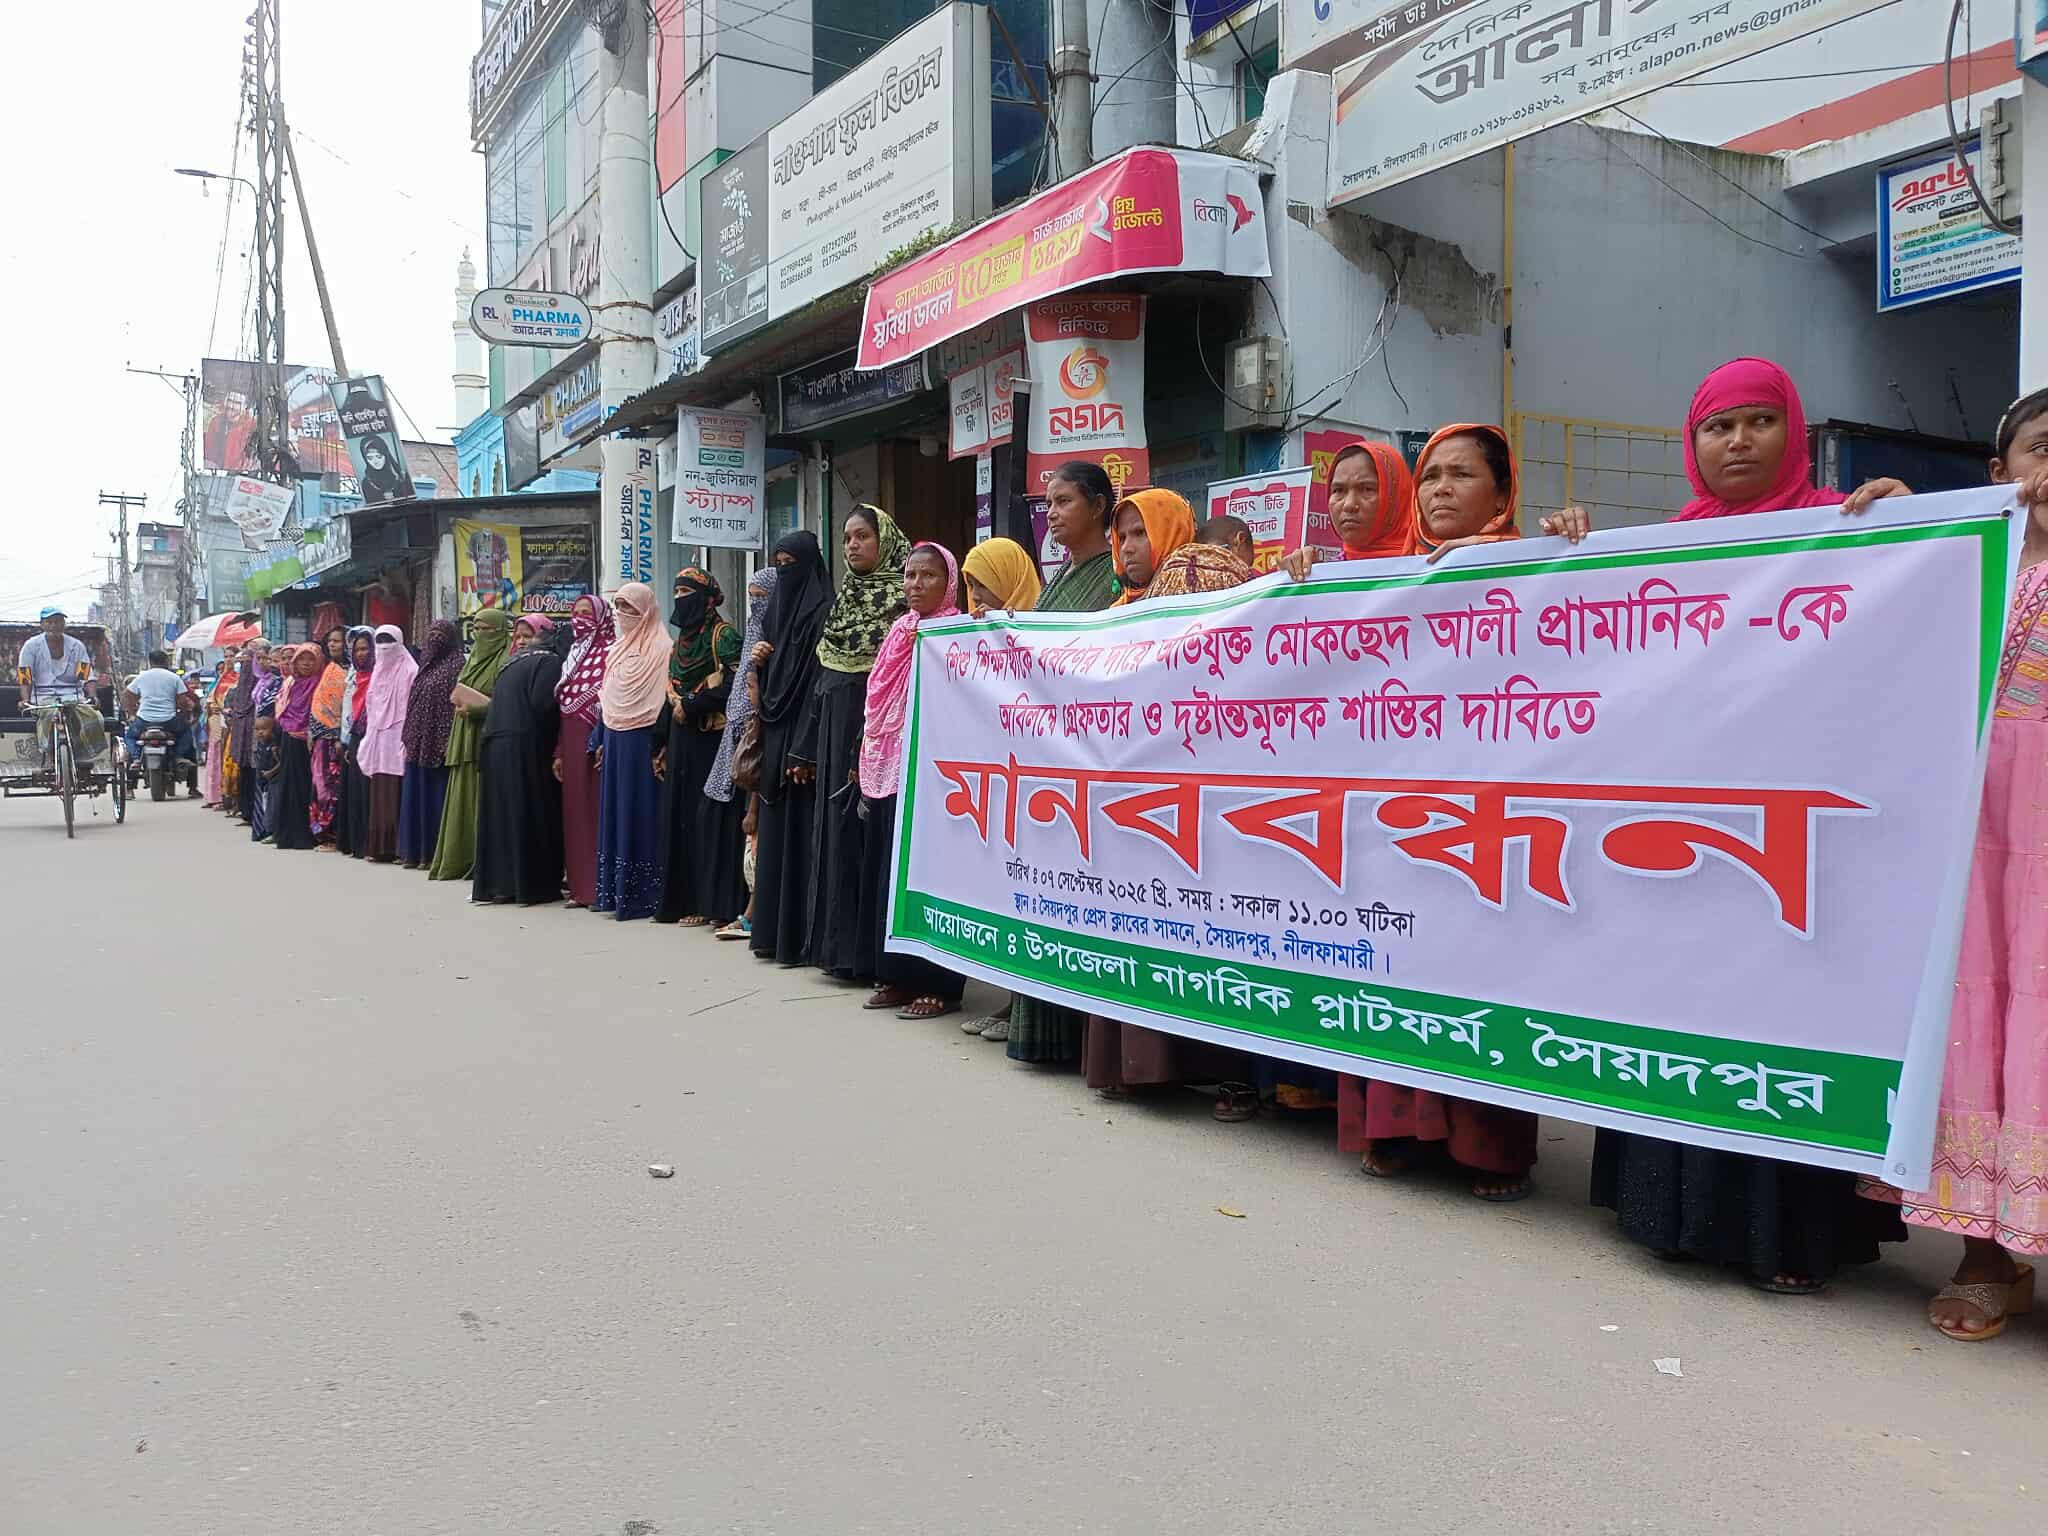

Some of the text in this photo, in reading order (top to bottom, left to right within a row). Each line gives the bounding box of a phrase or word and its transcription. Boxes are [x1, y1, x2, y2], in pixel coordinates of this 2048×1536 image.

[1364, 16, 1398, 45] শহীদ
[1419, 1, 1532, 61] দৈনিক
[1541, 1, 1732, 85] সব মানুষের সব
[773, 46, 943, 186] নাওশাদ ফুল বিতান
[1342, 165, 1380, 187] সৈয়দপুর,
[1383, 142, 1428, 169] নীলফামারী
[1577, 69, 1624, 95] ই-মেইল
[1113, 196, 1136, 215] প্রিয়
[1113, 208, 1163, 231] এজেন্টে
[1906, 195, 1946, 214] অফসেট
[482, 306, 582, 325] RL PHARMA
[873, 290, 953, 349] সুবিধা ডাবল
[991, 400, 1013, 425] নগ
[1048, 403, 1124, 436] নগদ
[685, 469, 757, 489] নন-জুডিসিয়াল
[685, 485, 755, 514] স্ট্যাম্প
[639, 449, 652, 583] RL PHARMA
[690, 516, 746, 532] পাওয়া যায়
[1229, 495, 1285, 515] বিদ্যুৎ টিভি
[523, 594, 560, 612] 10%
[1160, 621, 1253, 680] অভিযুক্ত
[1266, 615, 1412, 667] মোকছেদ
[1422, 588, 1522, 657] আলী
[1537, 578, 1730, 660] প্রামানিক
[1063, 696, 1133, 743] গ্রেফতার
[1141, 702, 1161, 736] ও
[1172, 686, 1329, 758] দৃষ্টান্তমূলক
[1340, 678, 1446, 743] শাস্তির
[1458, 674, 1602, 744] দাবিতে
[933, 751, 1874, 935] মানববন্ধন
[1006, 857, 1030, 882] তারিখ
[1041, 869, 1054, 889] ০৭
[1058, 867, 1103, 897] সেপ্টেম্বর
[1108, 879, 1148, 904] ২০২৫
[1177, 887, 1212, 913] সময়
[1230, 893, 1281, 921] সকাল
[1288, 900, 1348, 927] ১১.০০
[1355, 901, 1416, 938] ঘটিকা
[1013, 891, 1029, 913] স্থান
[1039, 893, 1079, 927] সৈয়দপুর
[1083, 907, 1107, 929] প্রেস
[1110, 911, 1149, 937] ক্লাবের
[1153, 917, 1200, 948] সামনে,
[1204, 919, 1277, 961] সৈয়দপুর,
[1282, 929, 1375, 972] নীলফামারী
[923, 904, 999, 953] আয়োজনে
[1024, 929, 1137, 988] উপজেলা
[1149, 961, 1293, 1017] নাগরিক
[1311, 989, 1505, 1066] প্লাটফর্ম,
[1526, 1017, 1833, 1120] সৈয়দপুর
